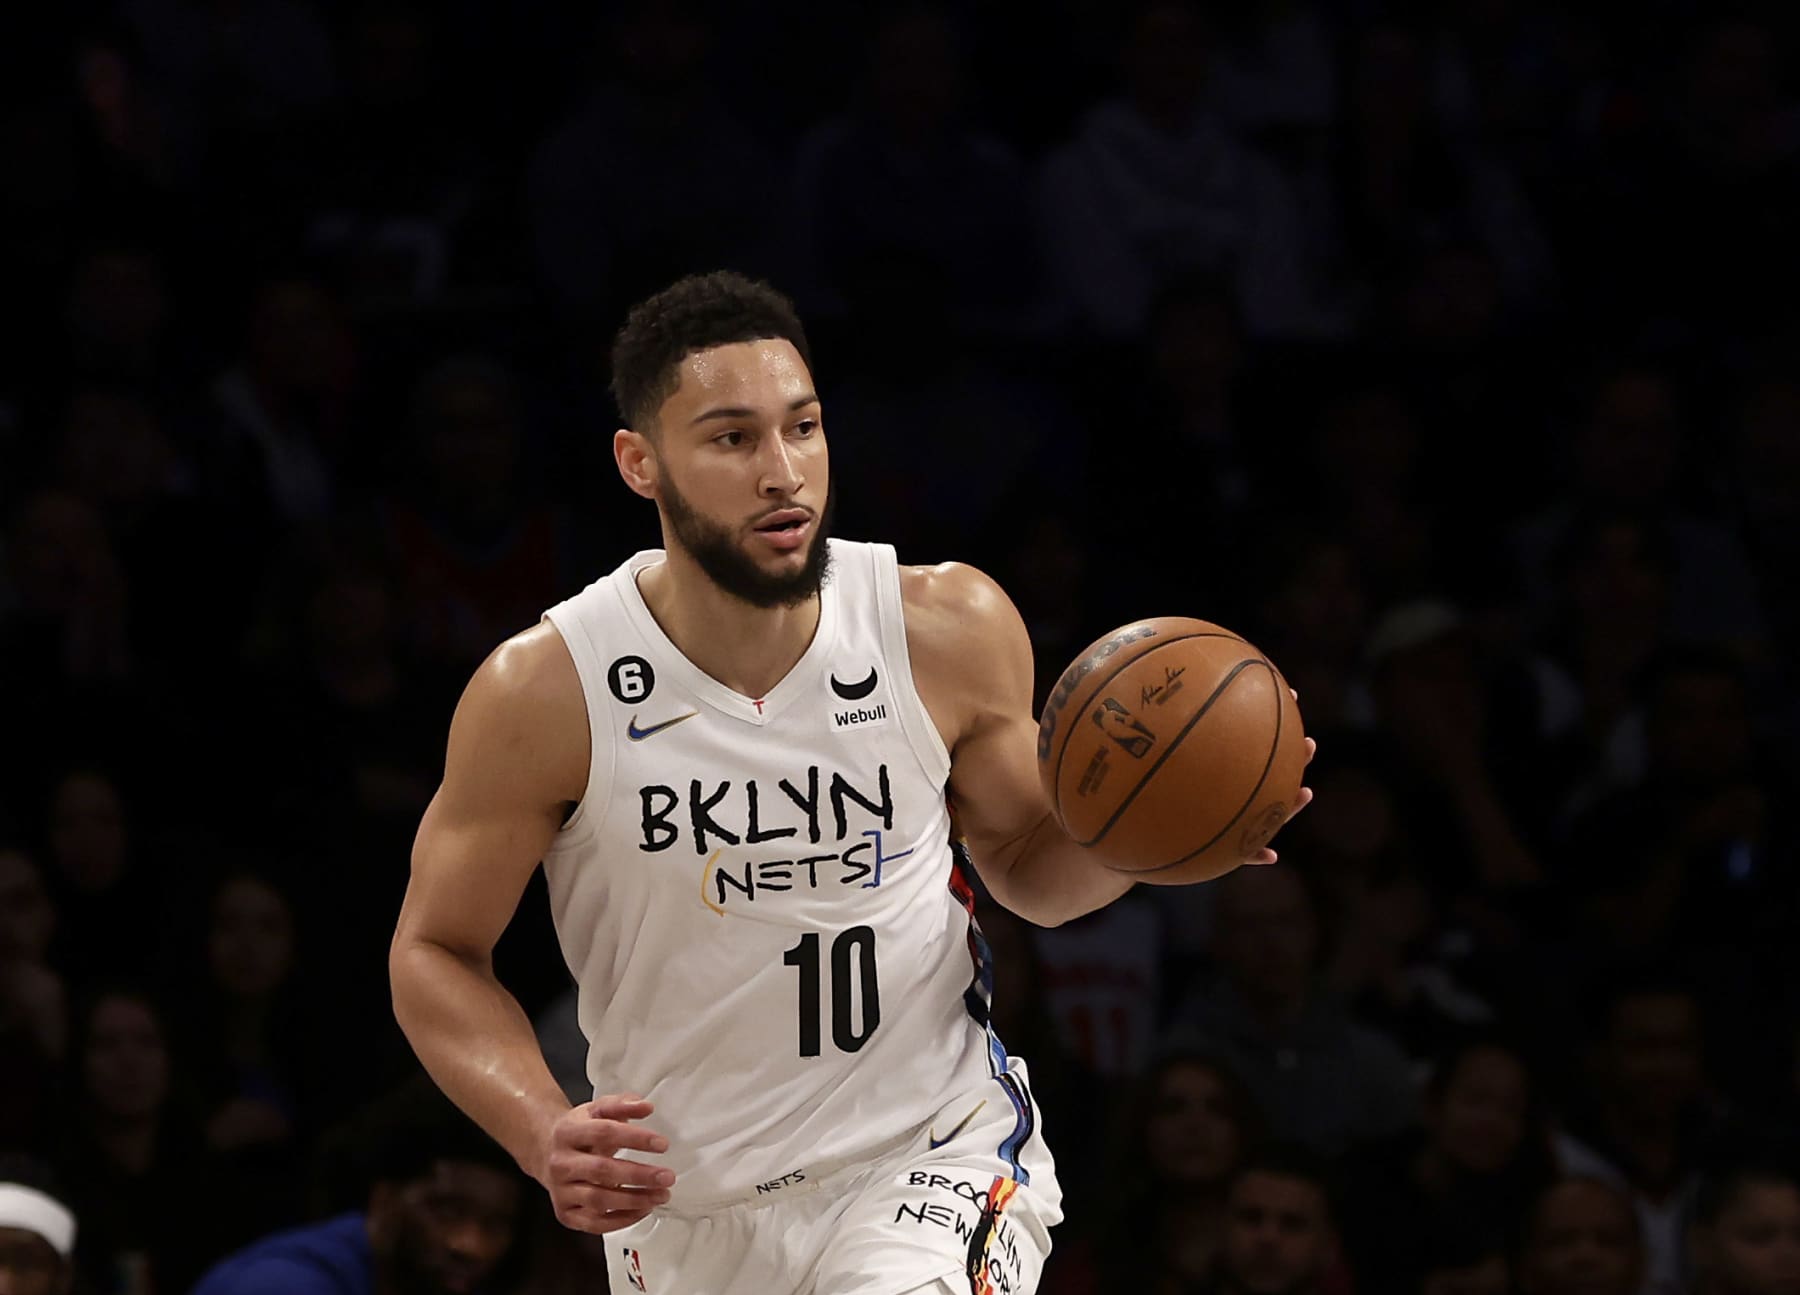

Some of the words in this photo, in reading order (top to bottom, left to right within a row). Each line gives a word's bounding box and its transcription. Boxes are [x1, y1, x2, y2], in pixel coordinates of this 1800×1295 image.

[618, 663, 645, 698] 6
[835, 705, 886, 726] Webull
[639, 764, 893, 855] BKLYN
[783, 925, 880, 1058] 10
[756, 1168, 806, 1195] NETS
[894, 1202, 973, 1246] NEW
